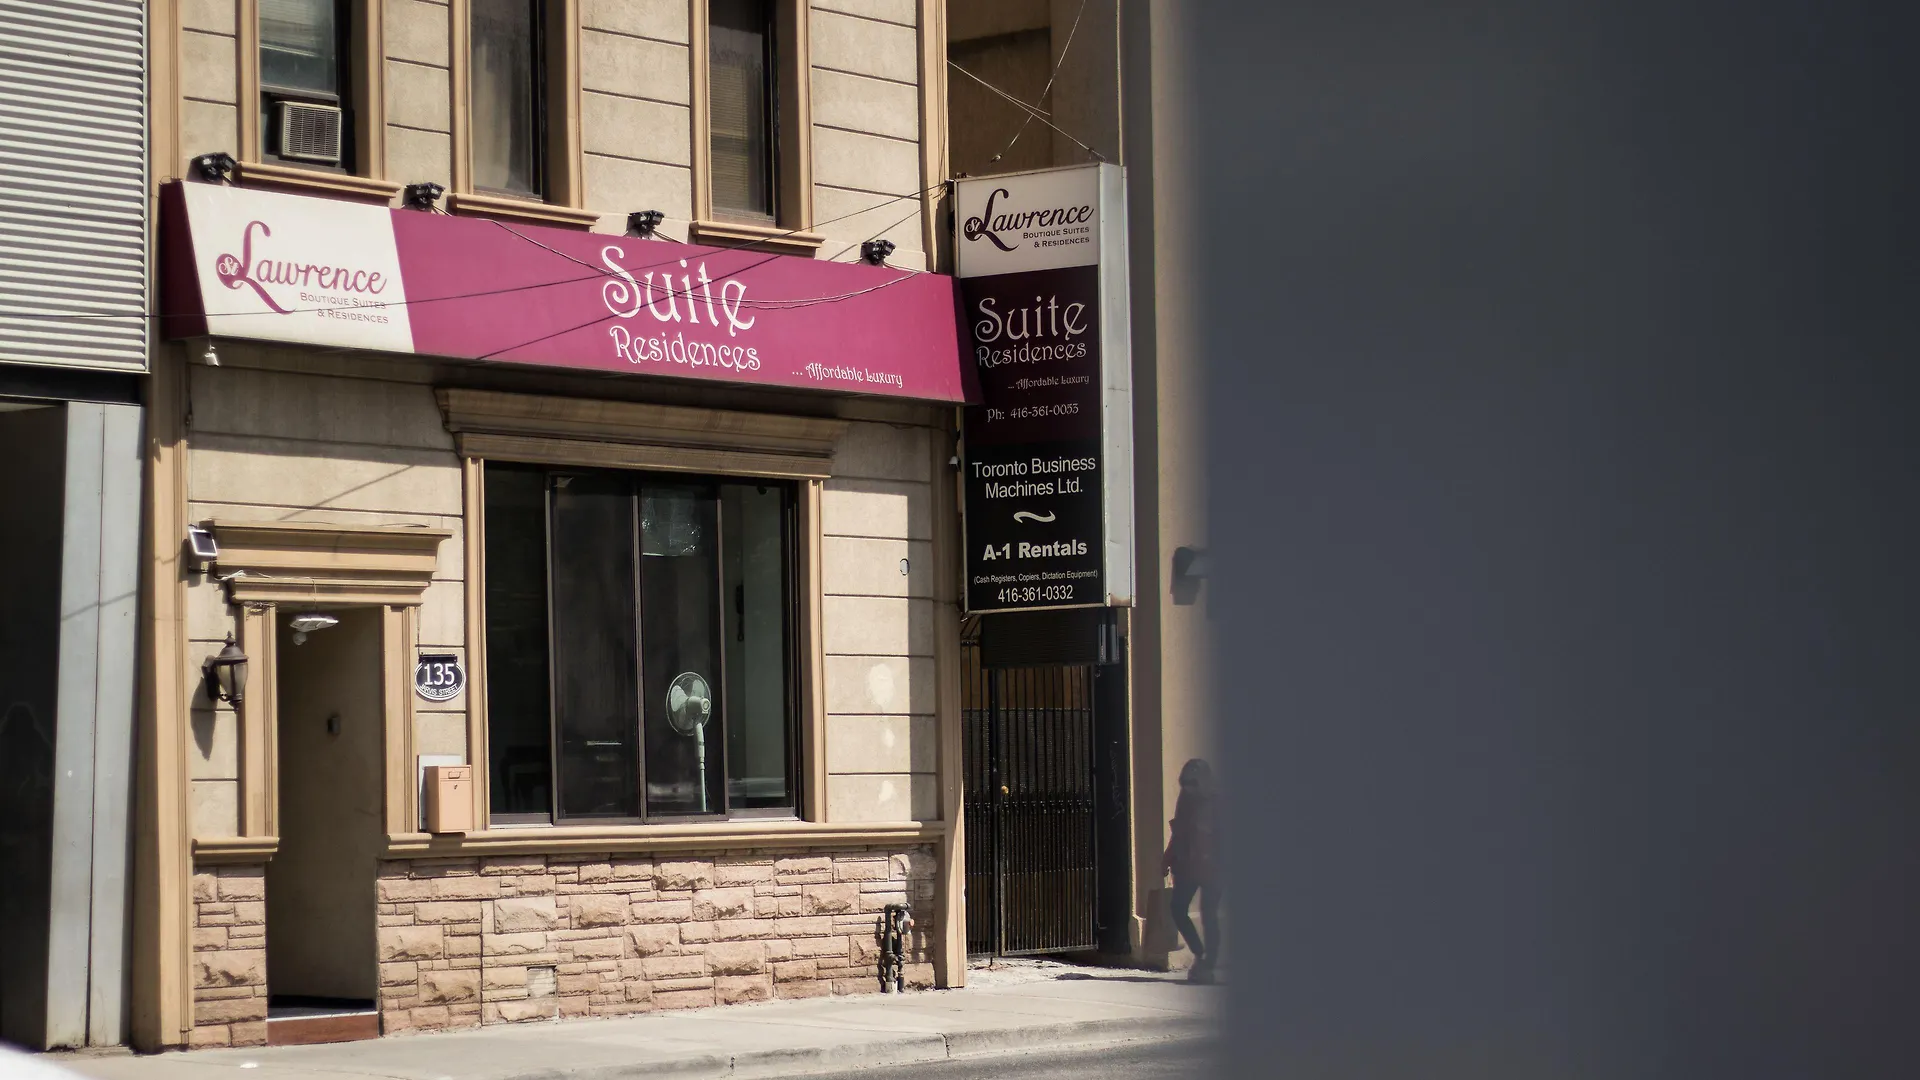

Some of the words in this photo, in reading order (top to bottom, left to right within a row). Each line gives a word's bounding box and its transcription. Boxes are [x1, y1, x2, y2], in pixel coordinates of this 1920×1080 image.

[964, 188, 1094, 252] Lawrence
[216, 220, 387, 315] Lawrence
[601, 246, 755, 337] Suite
[317, 308, 325, 317] &
[975, 295, 1088, 343] Suite
[609, 325, 761, 372] Residences
[976, 342, 1087, 368] Residences
[805, 362, 864, 382] Affordable
[865, 368, 903, 388] Luxury
[1016, 376, 1059, 390] Affordable
[1061, 375, 1090, 385] Luxury
[986, 408, 1005, 423] Ph:
[972, 461, 1028, 478] Toronto
[1031, 456, 1096, 474] Business
[985, 480, 1054, 499] Machines
[1058, 477, 1083, 494] Ltd.
[982, 543, 1011, 561] A-1
[1018, 539, 1088, 559] Rentals
[973, 575, 990, 585] (Cash
[990, 574, 1018, 584] Registers,
[1042, 571, 1066, 580] Dictation
[1066, 569, 1098, 579] Equipment)
[998, 584, 1073, 603] 416-361-0332
[424, 663, 455, 685] 135
